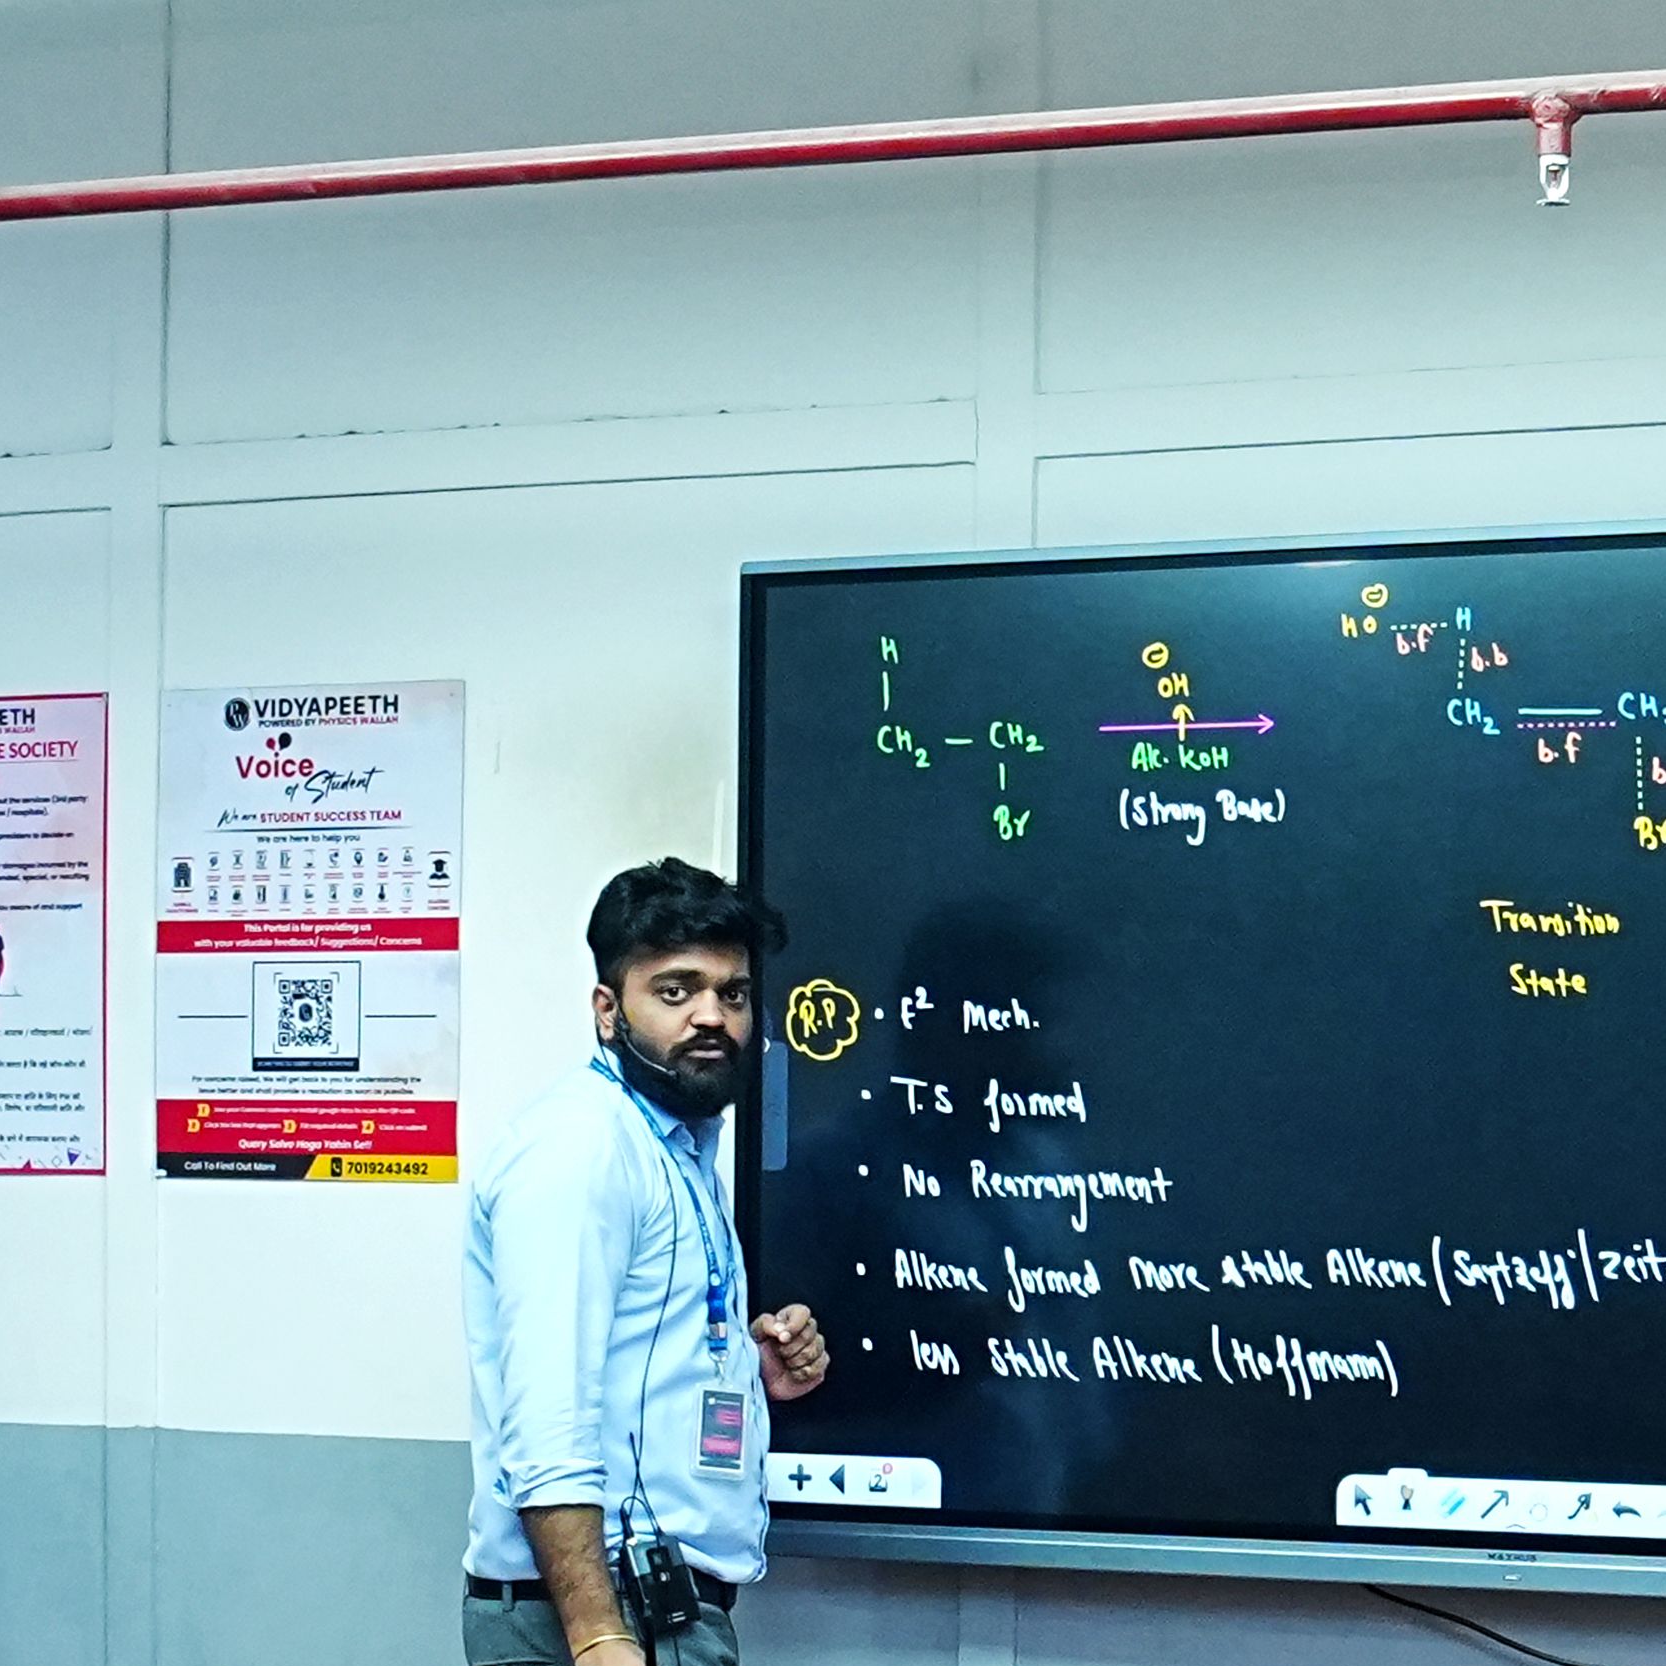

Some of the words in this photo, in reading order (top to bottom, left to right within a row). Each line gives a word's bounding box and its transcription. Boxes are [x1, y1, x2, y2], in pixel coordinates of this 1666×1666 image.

[881, 637, 898, 663] H
[254, 695, 399, 717] VIDYAPEETH
[259, 719, 302, 728] POWERED
[305, 718, 316, 726] BY
[319, 717, 358, 726] PHYSICS
[361, 716, 398, 724] WALLAH
[9, 741, 78, 758] SOCIETY
[236, 752, 314, 779] Voice
[304, 766, 384, 804] Student
[260, 813, 312, 823] STUDENT
[314, 812, 367, 822] SUCCESS
[369, 810, 401, 820] TEAM
[290, 835, 308, 843] here
[322, 835, 341, 843] help
[344, 835, 360, 843] you
[184, 1161, 202, 1170] Call
[204, 1161, 215, 1170] To
[216, 1161, 234, 1170] Find
[236, 1162, 252, 1170] Out
[347, 1162, 428, 1174] 7019243492
[903, 1164, 940, 1197] No
[971, 1160, 1172, 1232] Rearrangement
[896, 1249, 988, 1292] Alkene
[1005, 1246, 1100, 1312] formed
[1327, 1247, 1426, 1286] Alkene
[1093, 1336, 1202, 1383] Alkene
